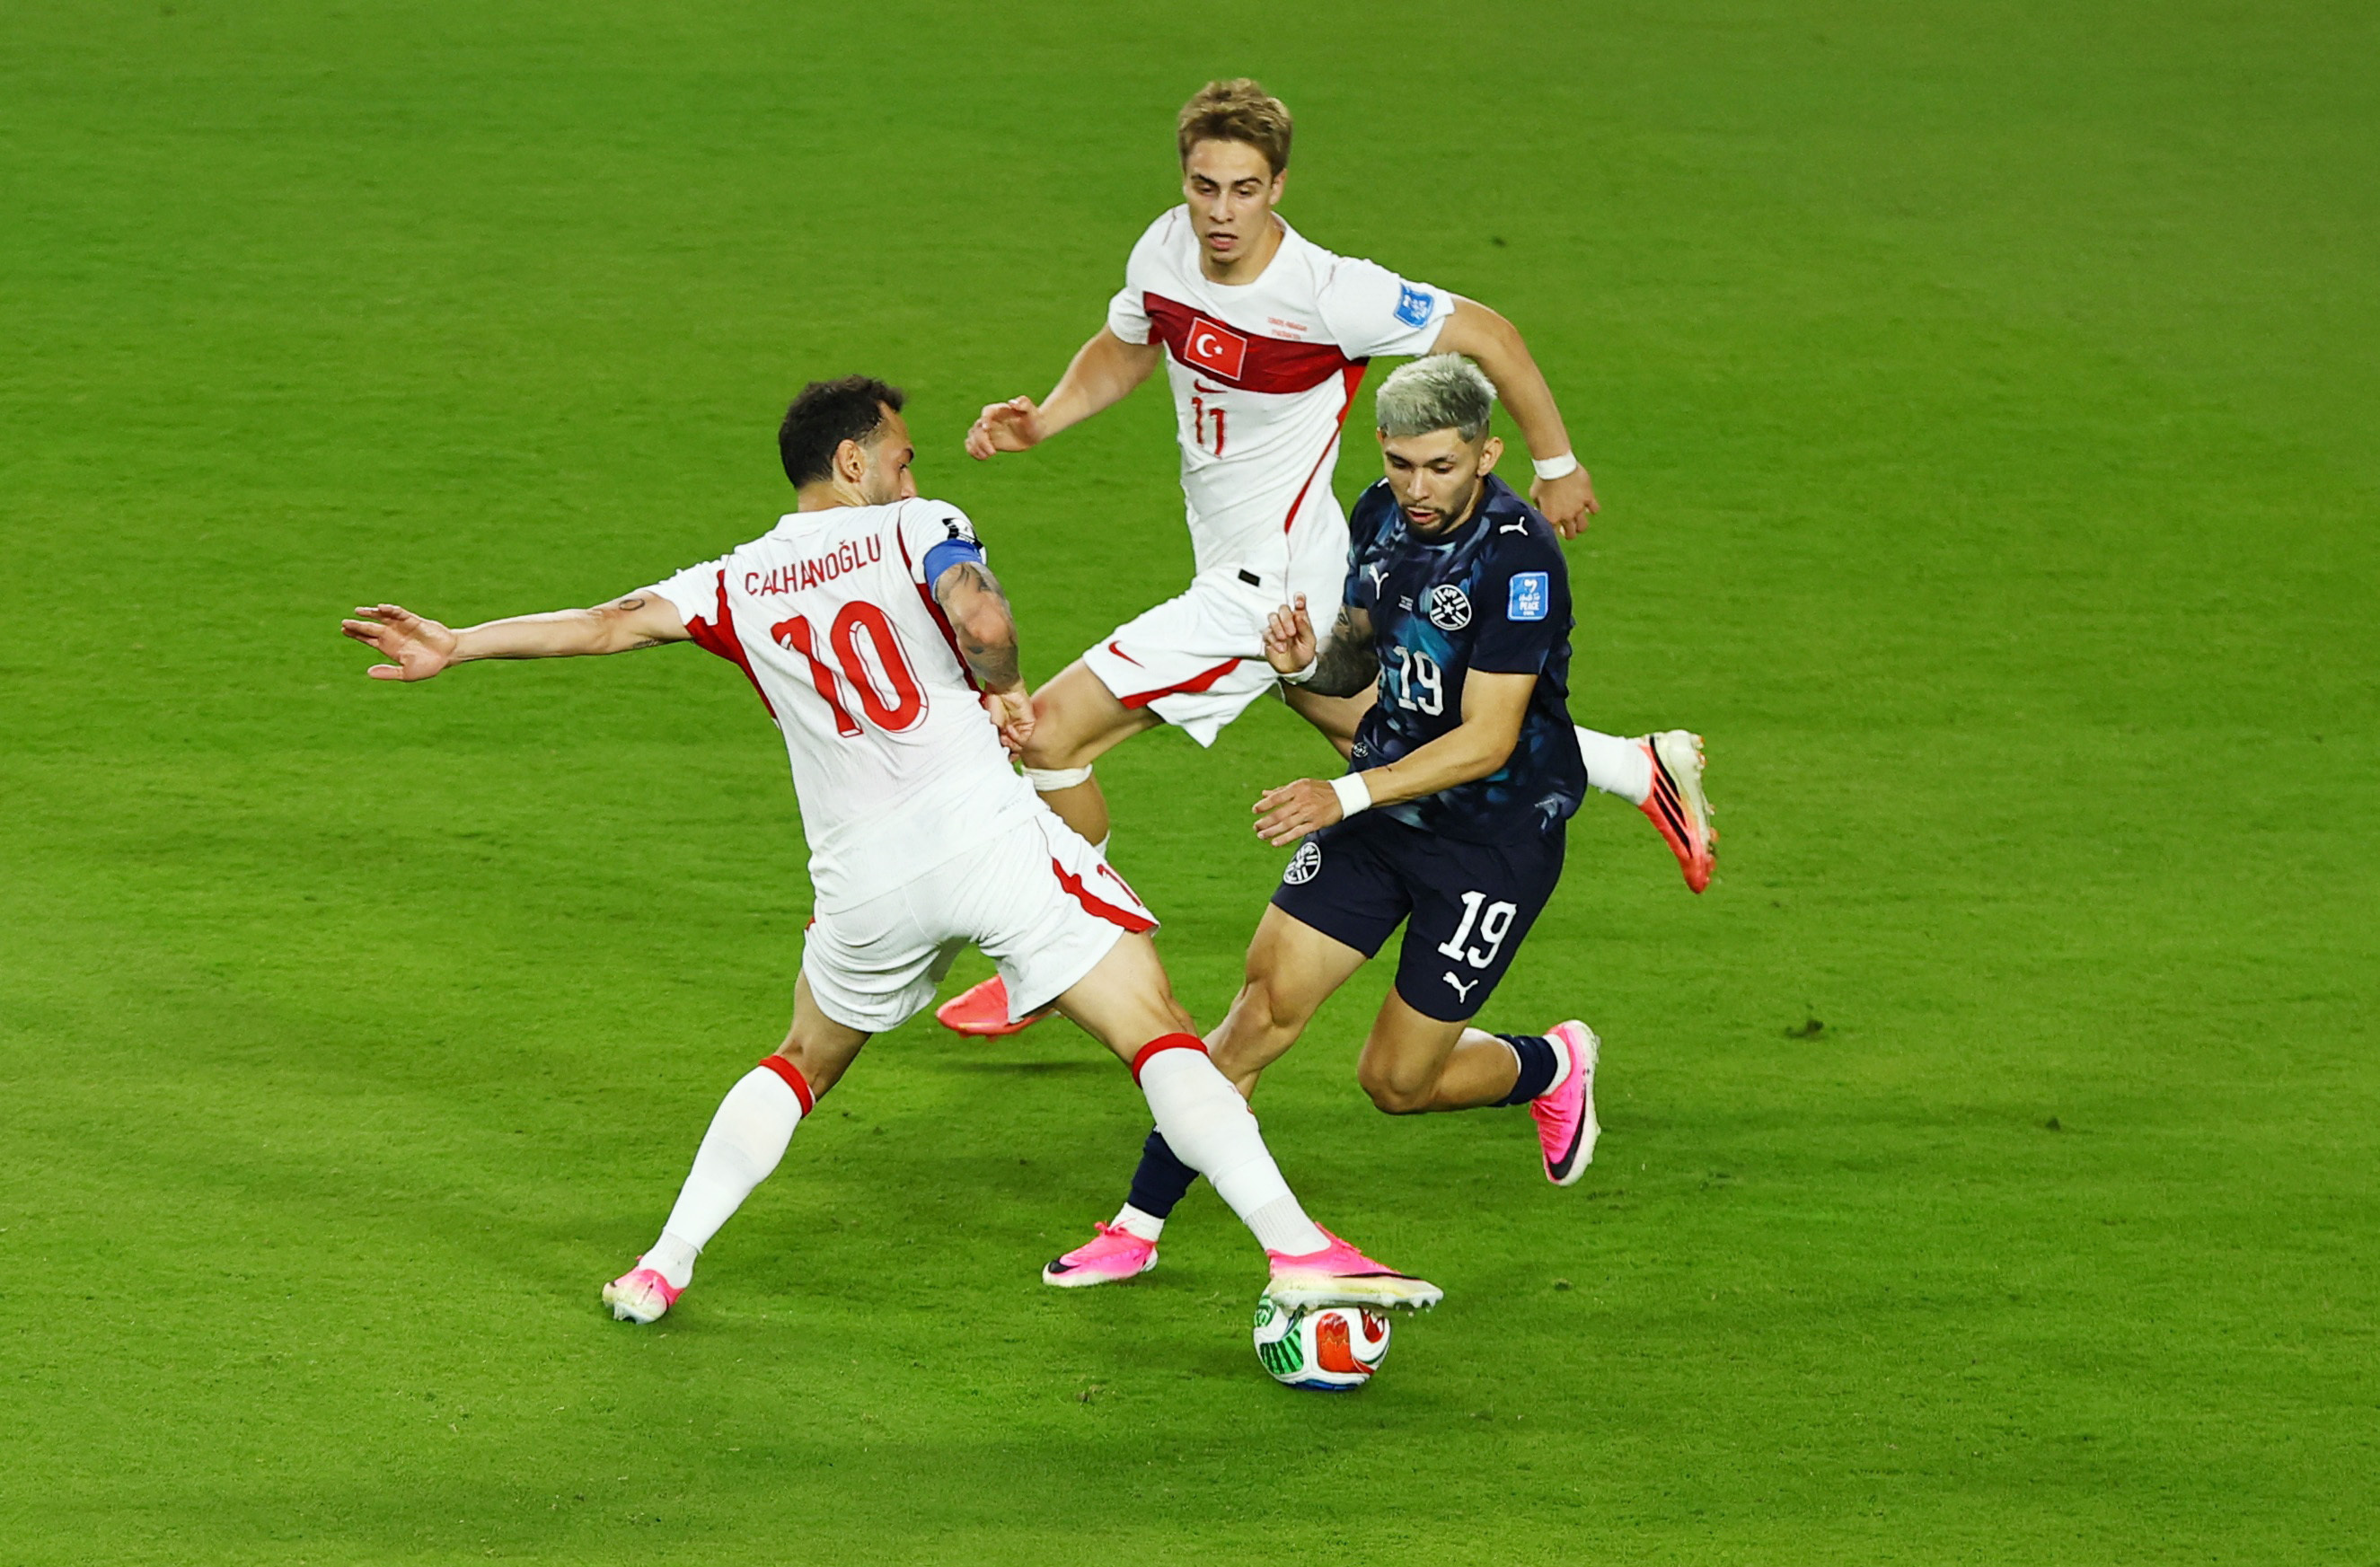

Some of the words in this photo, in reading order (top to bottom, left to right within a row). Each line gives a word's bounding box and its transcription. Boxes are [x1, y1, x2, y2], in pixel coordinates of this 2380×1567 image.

[1192, 396, 1228, 458] 11
[771, 600, 930, 738] 10
[1393, 645, 1444, 716] 19
[1438, 890, 1518, 969] 19
